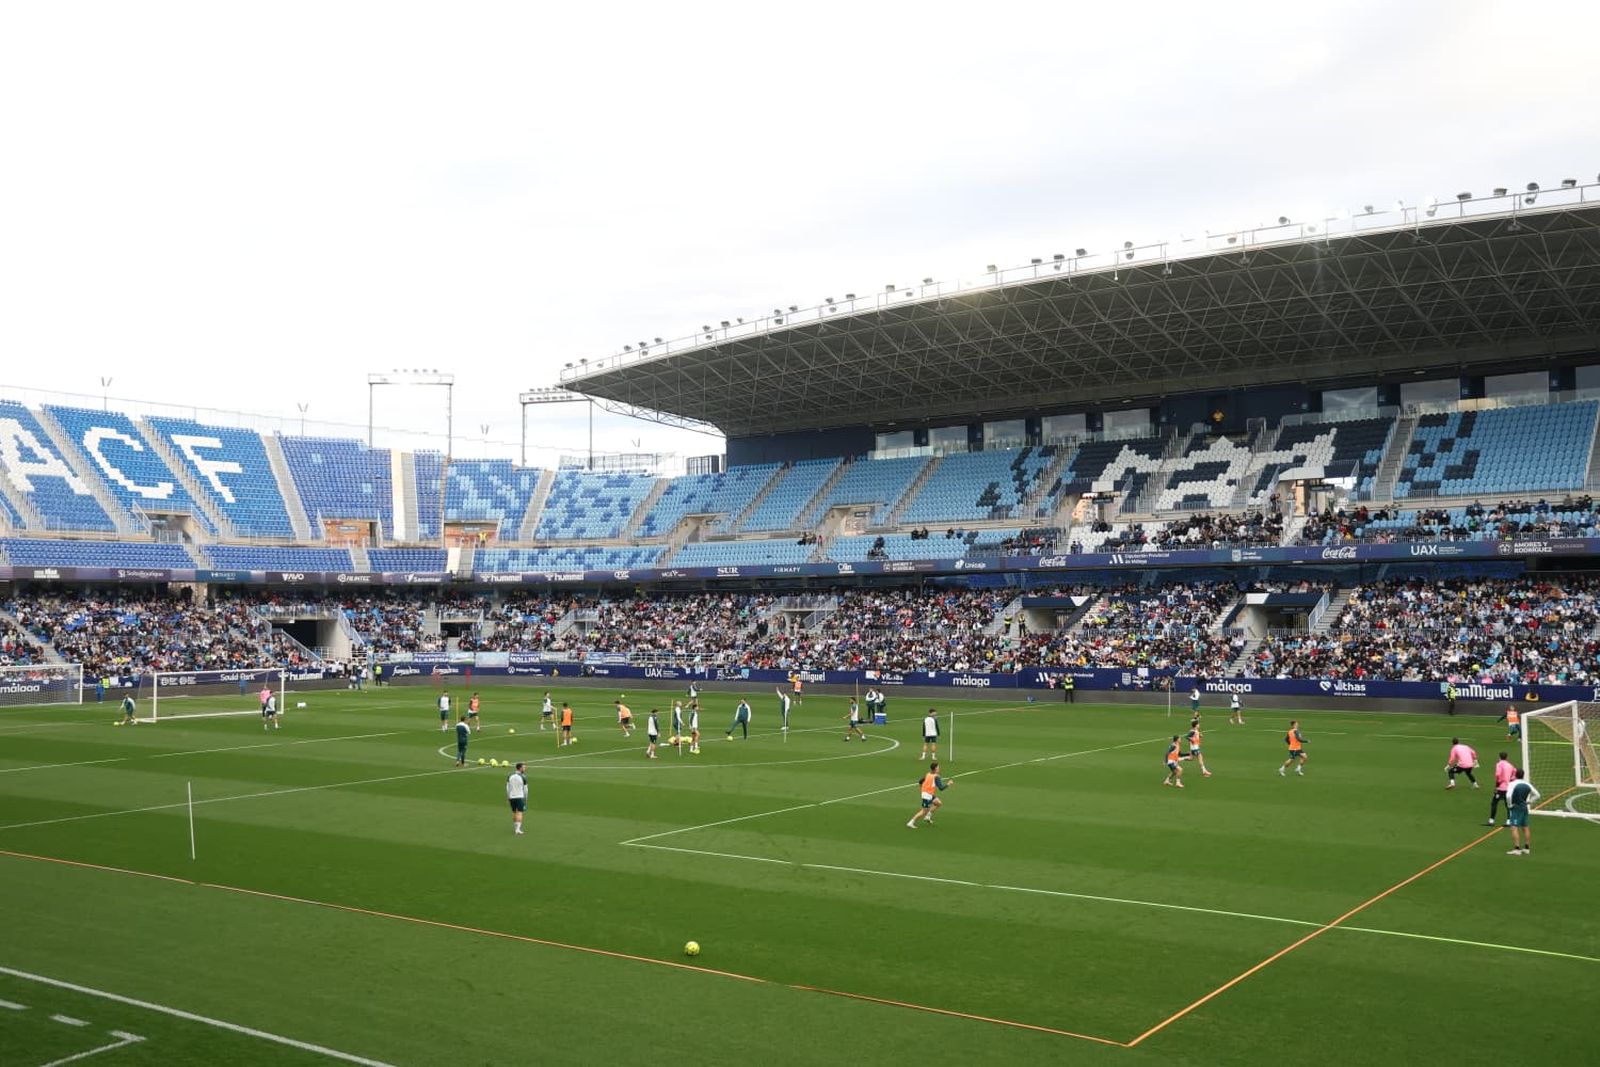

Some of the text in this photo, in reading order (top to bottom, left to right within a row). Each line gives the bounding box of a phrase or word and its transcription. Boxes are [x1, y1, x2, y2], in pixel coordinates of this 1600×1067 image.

[1411, 545, 1437, 555] UAX
[491, 574, 522, 582] hummel
[554, 572, 584, 581] hummel
[645, 668, 662, 678] UAX
[953, 674, 990, 687] málaga
[1333, 680, 1366, 691] vithas
[1206, 679, 1251, 693] málaga
